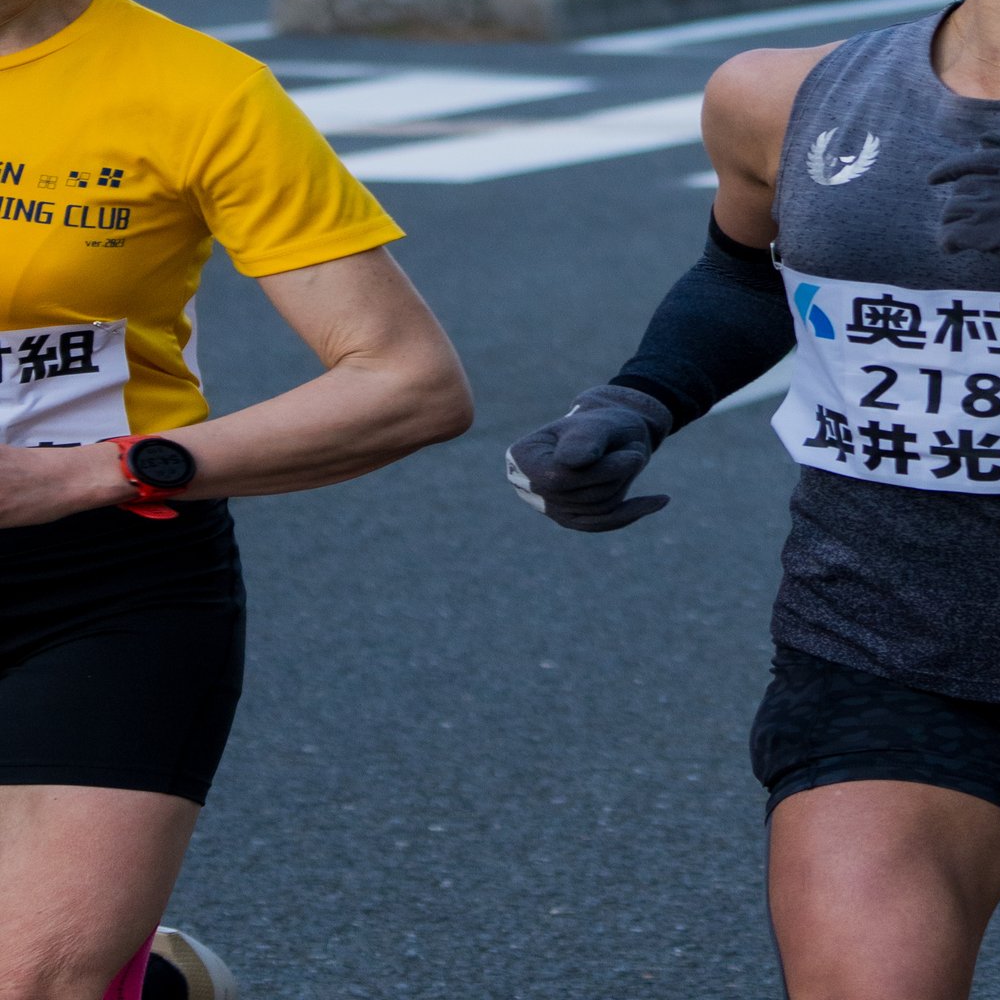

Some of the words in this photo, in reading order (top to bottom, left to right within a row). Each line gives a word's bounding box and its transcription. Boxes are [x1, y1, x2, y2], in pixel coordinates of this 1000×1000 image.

[0, 161, 25, 186] N
[0, 196, 55, 225] ING
[63, 204, 131, 231] CLUB
